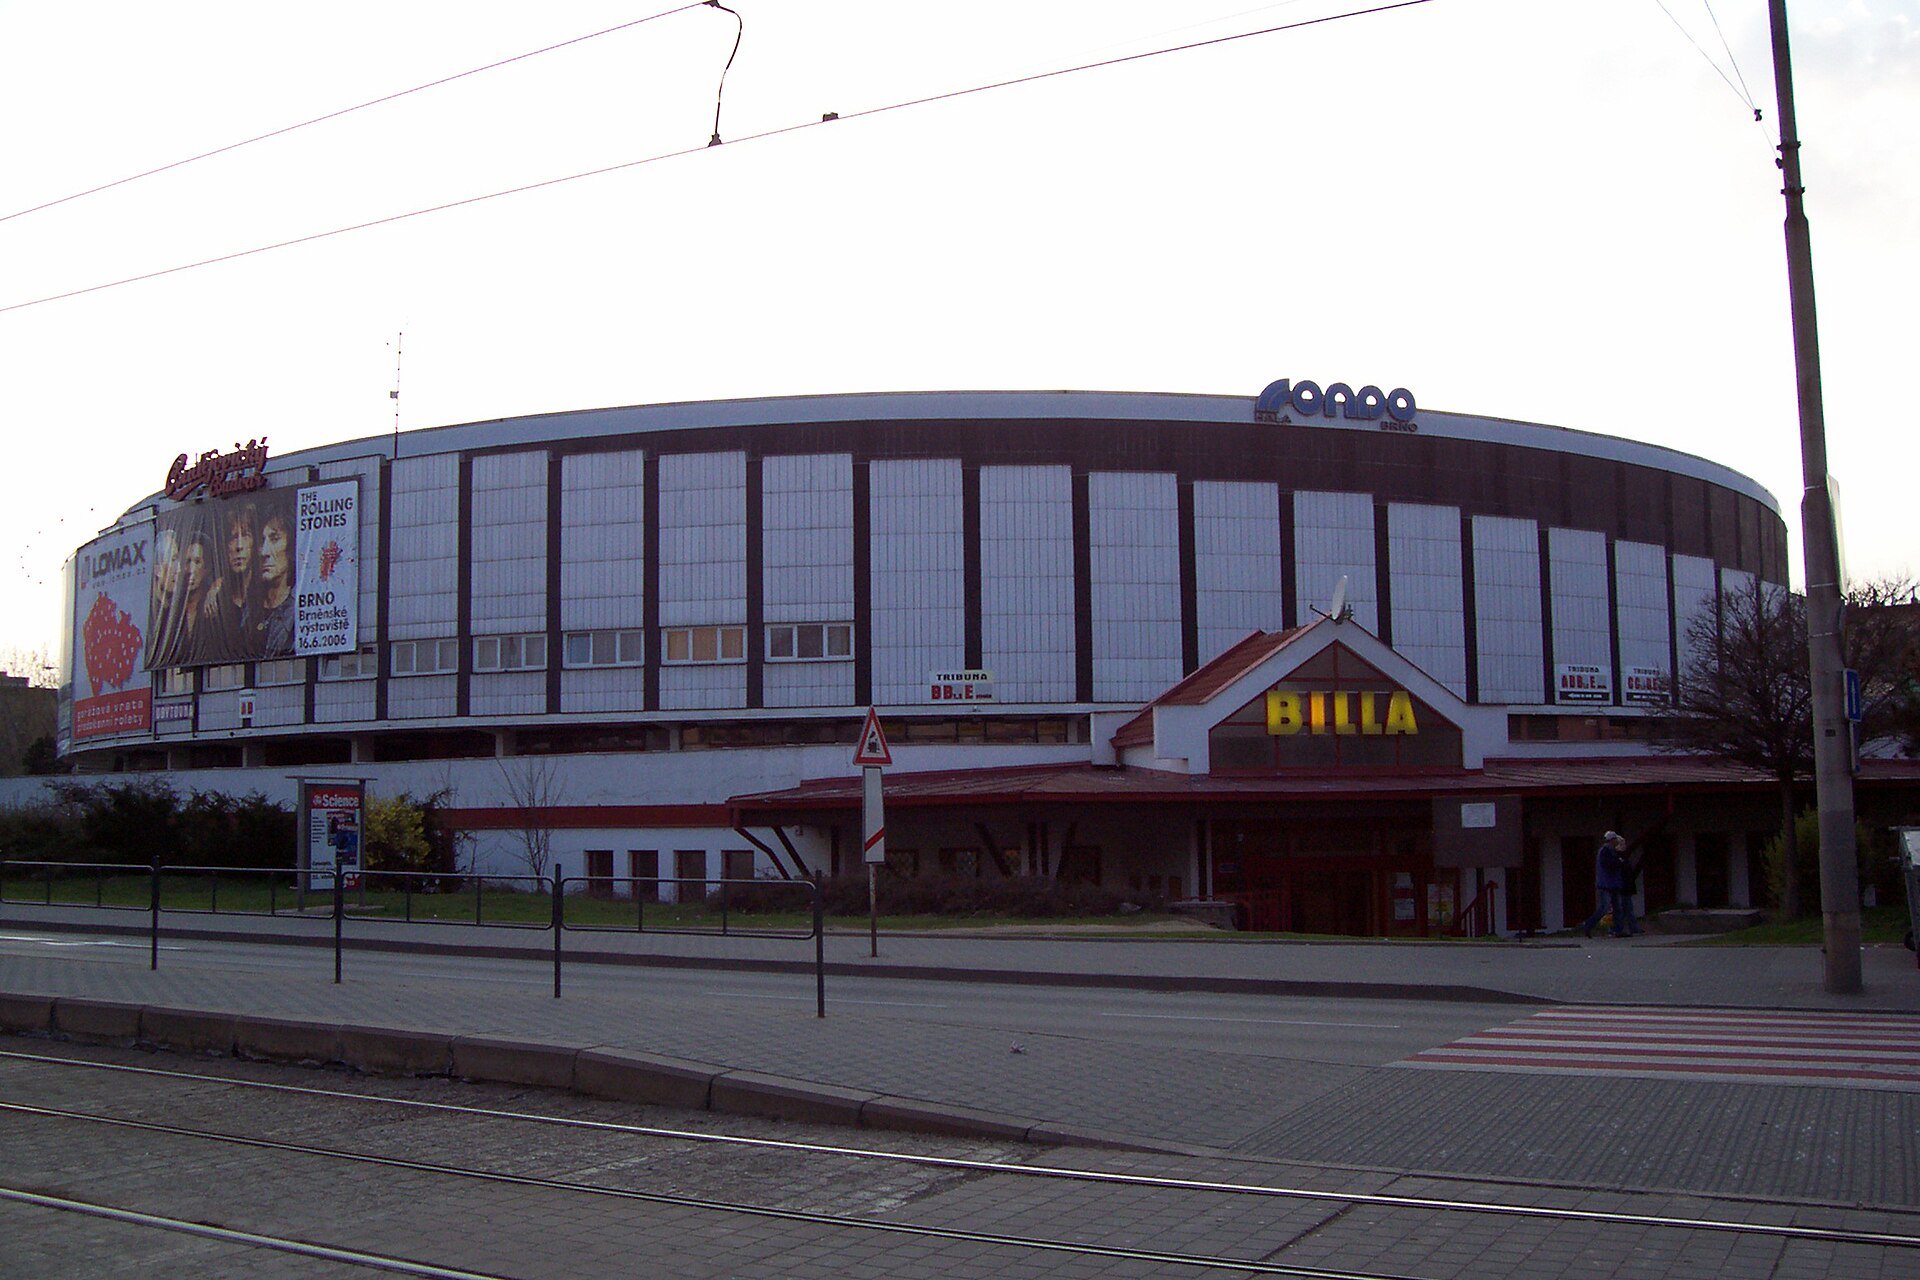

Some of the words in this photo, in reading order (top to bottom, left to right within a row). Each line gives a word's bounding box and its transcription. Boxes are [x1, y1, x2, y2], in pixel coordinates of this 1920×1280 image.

[1379, 421, 1418, 433] BRNO
[300, 491, 318, 503] THE
[300, 497, 354, 518] ROLLING
[300, 512, 347, 532] STONES
[92, 539, 148, 579] LOMAX
[298, 591, 336, 608] BRNO
[299, 605, 348, 622] Brněnské
[299, 618, 350, 637] výstaviště
[298, 633, 347, 650] 16.6.2006
[936, 673, 988, 681] TRIBUNA
[113, 700, 144, 712] vrata
[1266, 690, 1419, 736] BILLA
[114, 714, 144, 726] rolety
[322, 794, 359, 807] Science
